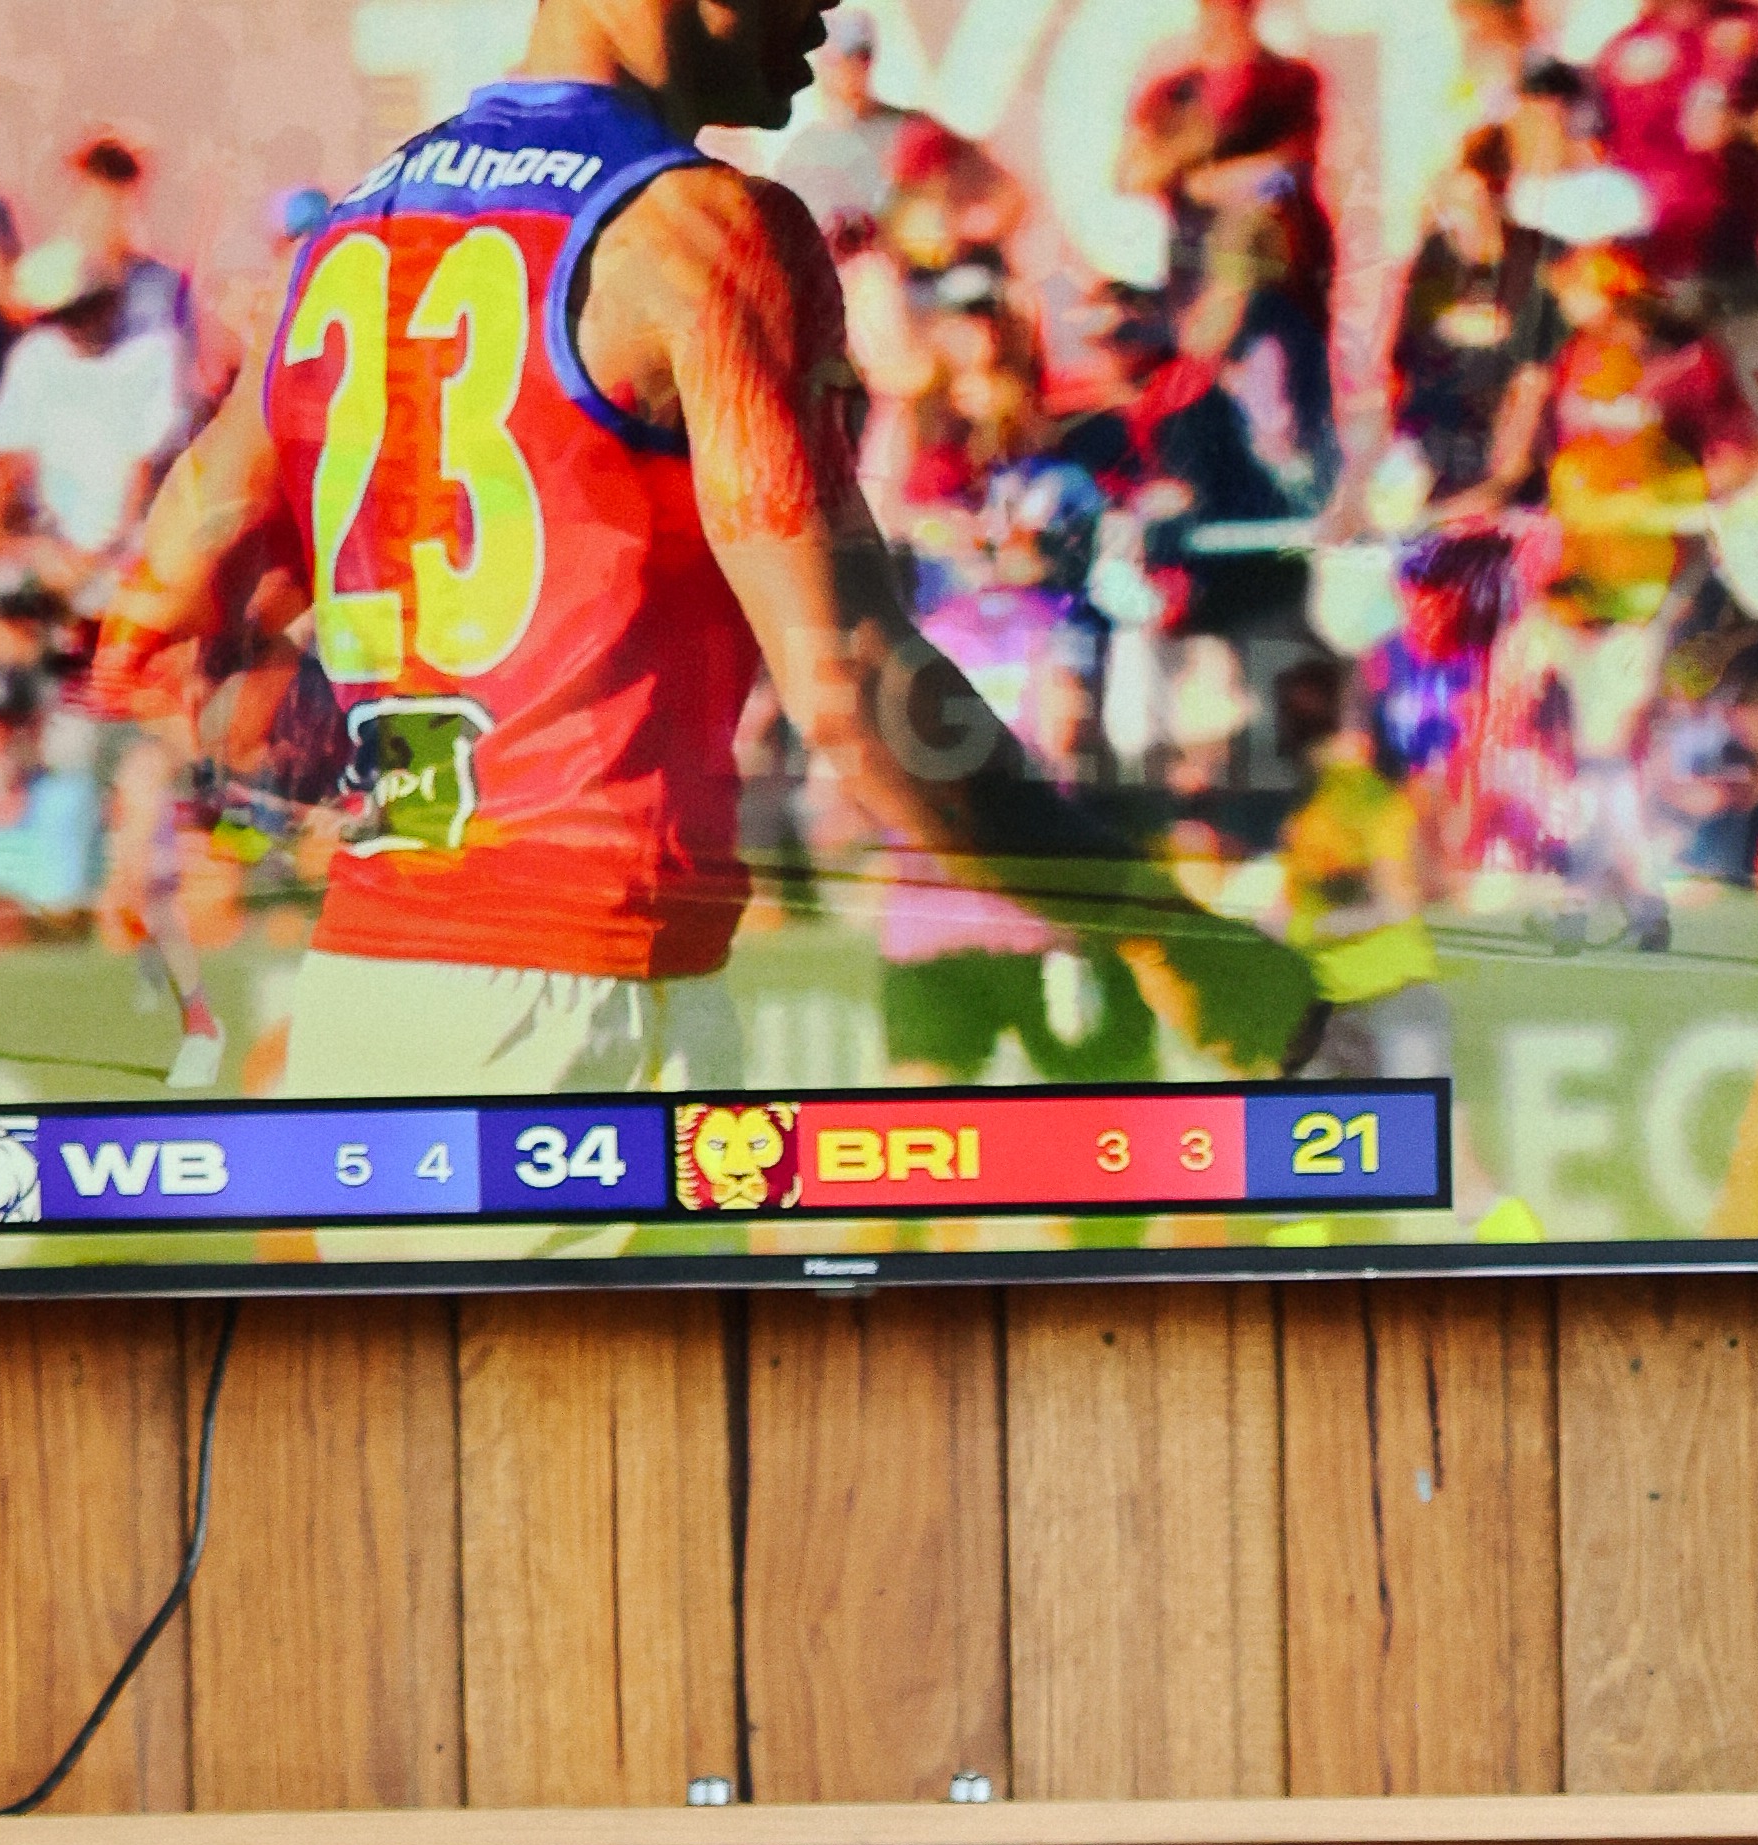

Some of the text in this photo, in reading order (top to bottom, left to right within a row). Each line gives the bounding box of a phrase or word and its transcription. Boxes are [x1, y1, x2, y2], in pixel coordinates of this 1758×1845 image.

[284, 226, 544, 682] 23
[60, 1141, 229, 1199] WB
[333, 1142, 372, 1186] 5
[414, 1142, 454, 1185] 4
[513, 1124, 628, 1188] 34
[816, 1126, 981, 1182] BRI
[1095, 1129, 1131, 1172] 3
[1178, 1127, 1215, 1172] 3
[1291, 1111, 1381, 1175] 21
